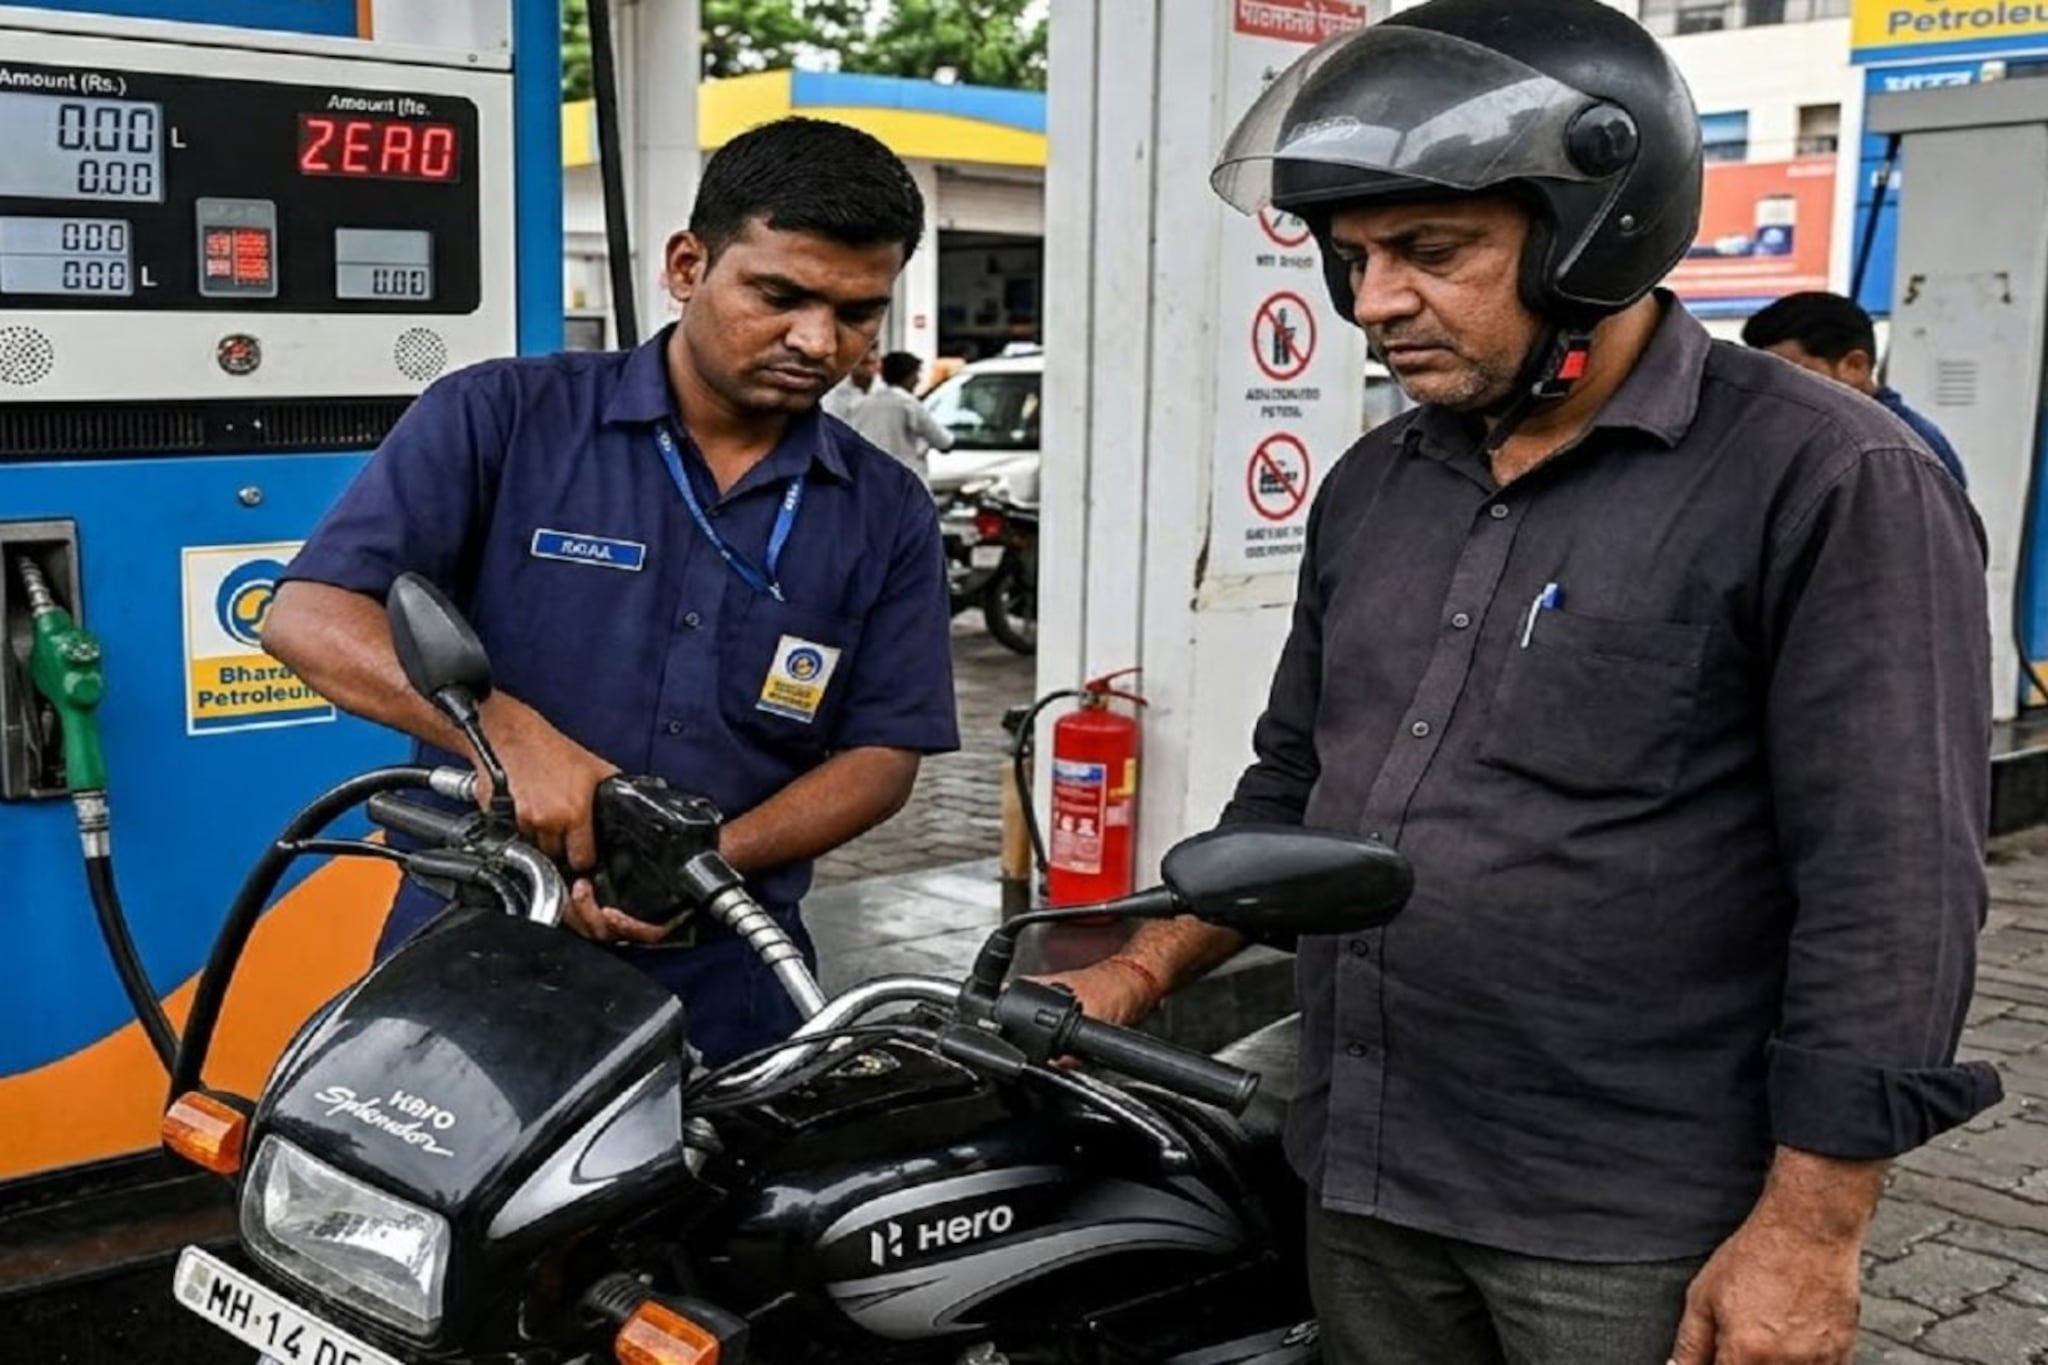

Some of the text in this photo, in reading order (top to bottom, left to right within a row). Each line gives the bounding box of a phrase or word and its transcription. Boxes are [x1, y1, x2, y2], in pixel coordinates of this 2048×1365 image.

[1888, 1, 2048, 35] Petroleu
[0, 68, 127, 96] Amount (Rs.)
[58, 103, 153, 154] 0.00
[171, 127, 187, 149] L
[141, 265, 158, 287] L
[219, 666, 296, 684] Bhara
[917, 1204, 1014, 1251] Hero
